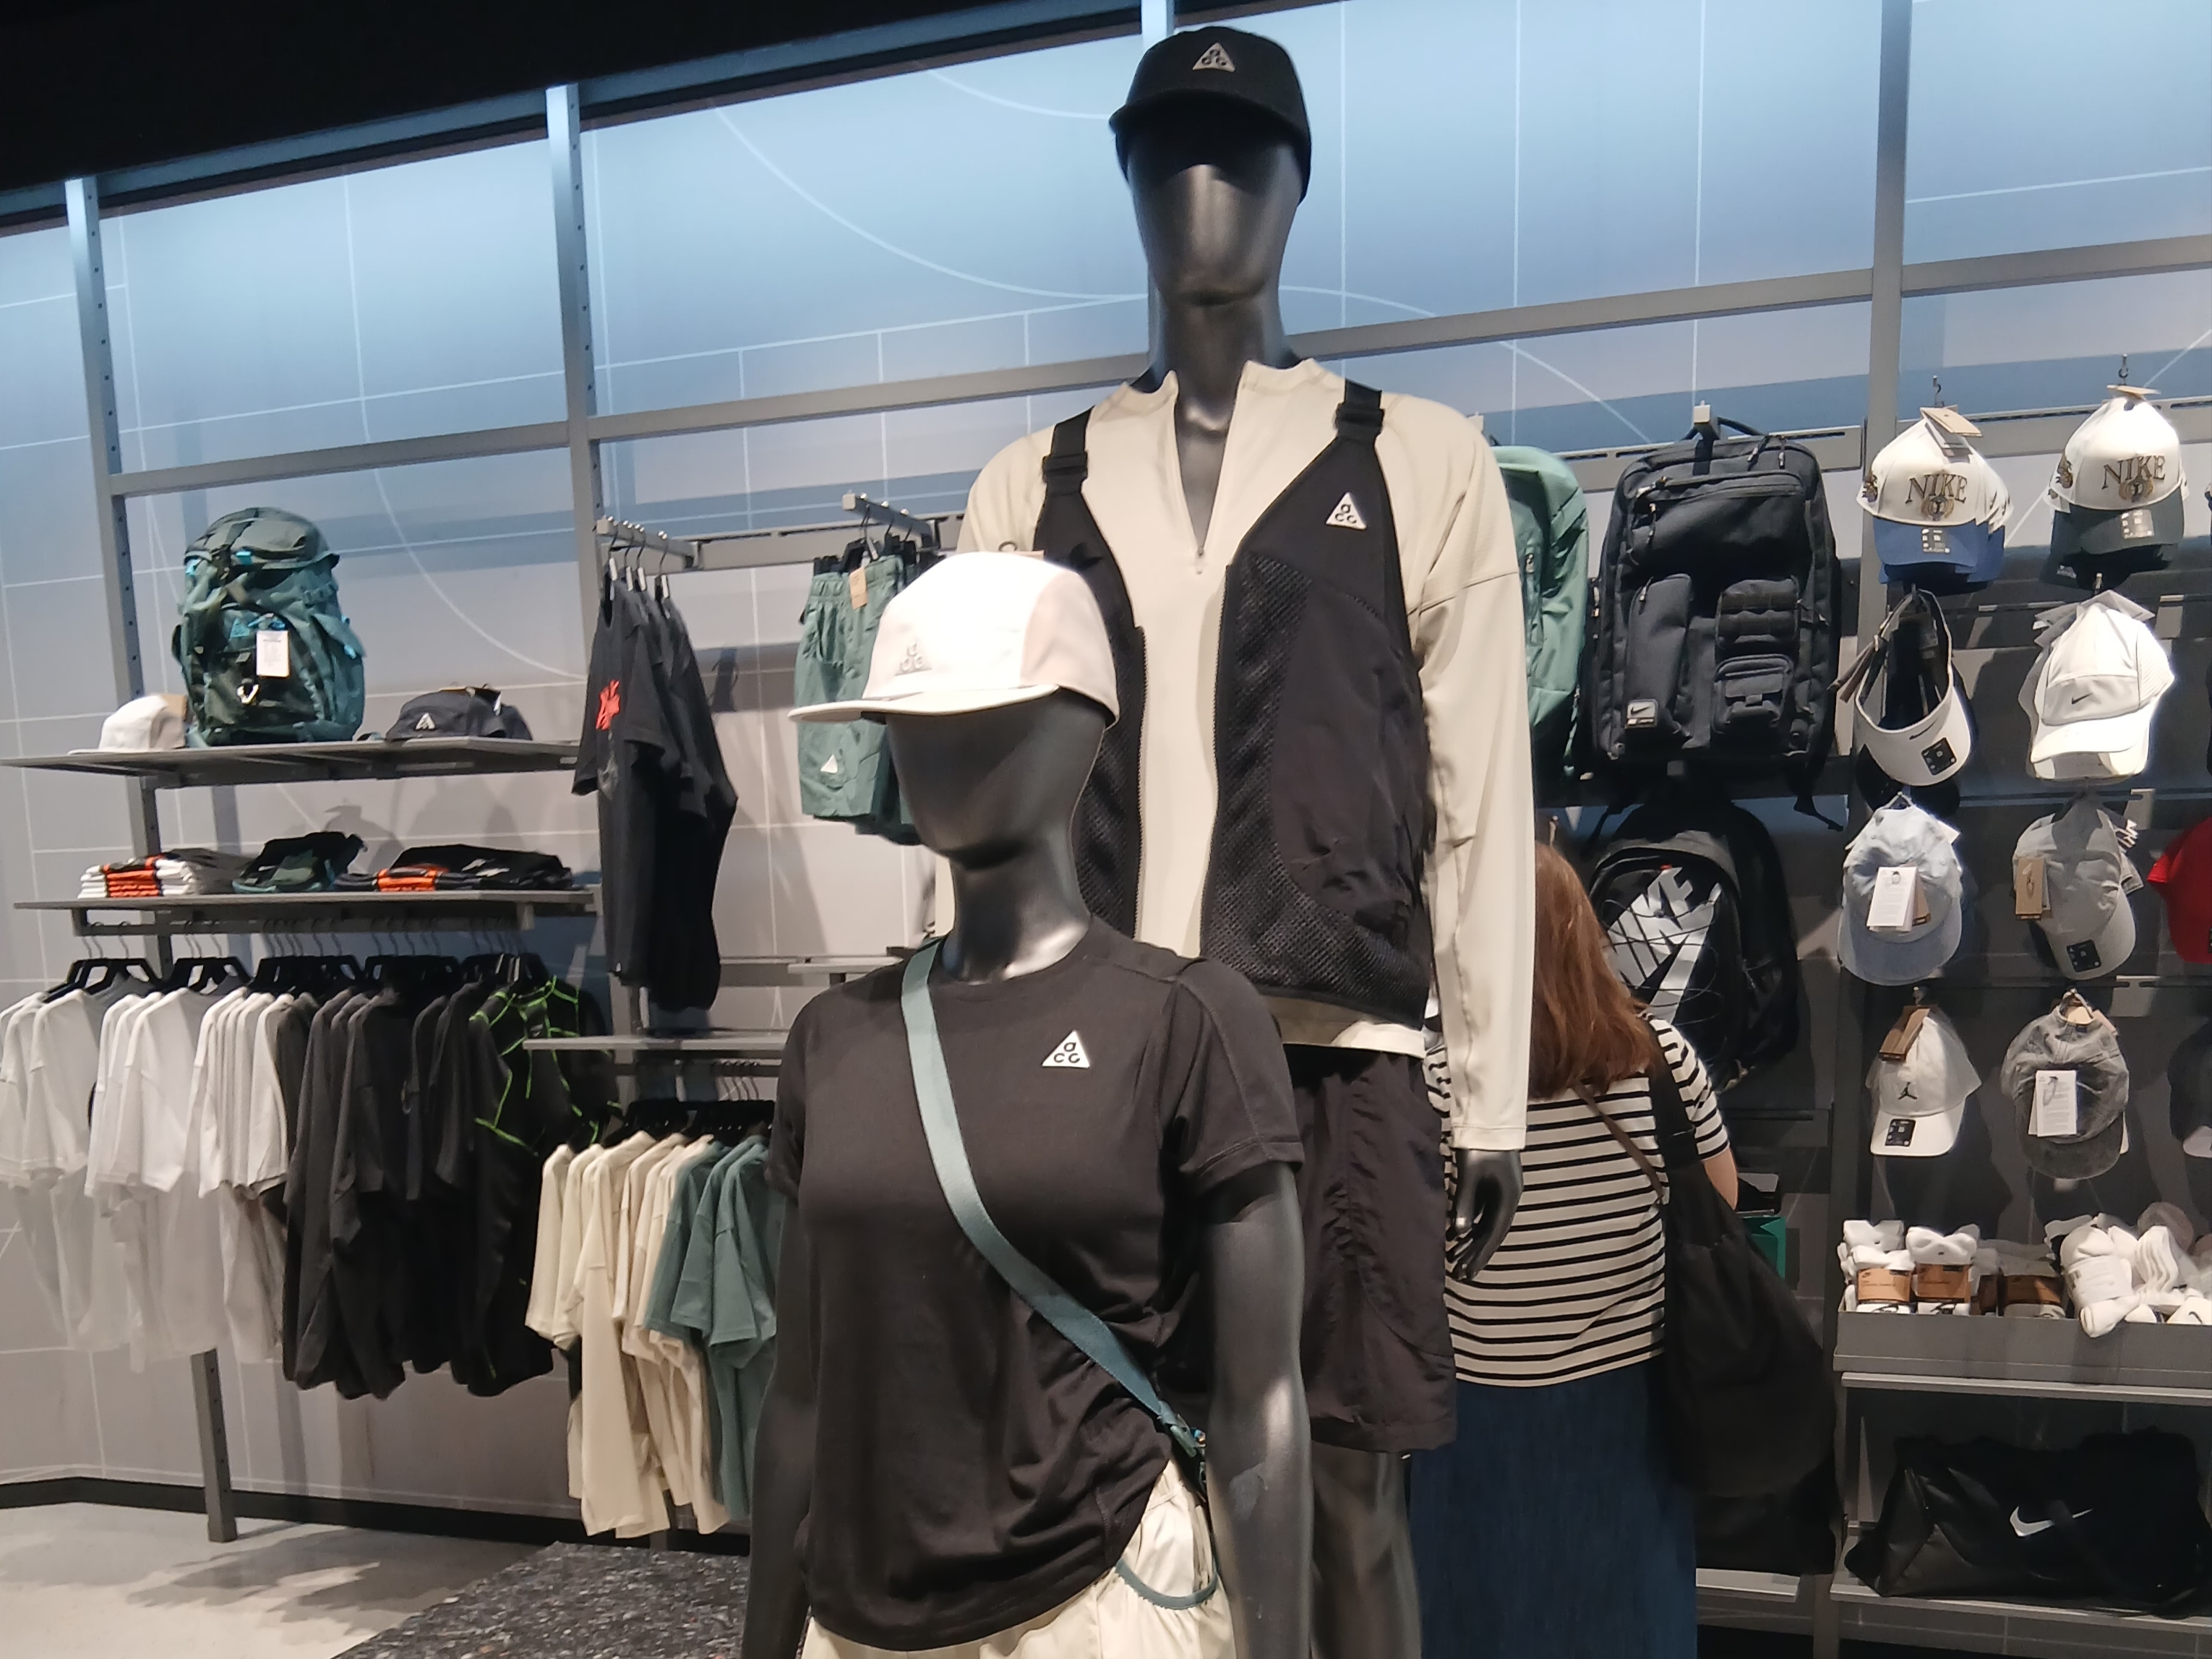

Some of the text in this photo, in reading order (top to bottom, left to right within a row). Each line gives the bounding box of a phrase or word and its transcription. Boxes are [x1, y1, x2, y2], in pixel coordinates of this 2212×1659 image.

[1905, 473, 1968, 505] NIKE
[2101, 455, 2166, 490] NIKE
[1600, 867, 1694, 990] NIKE
